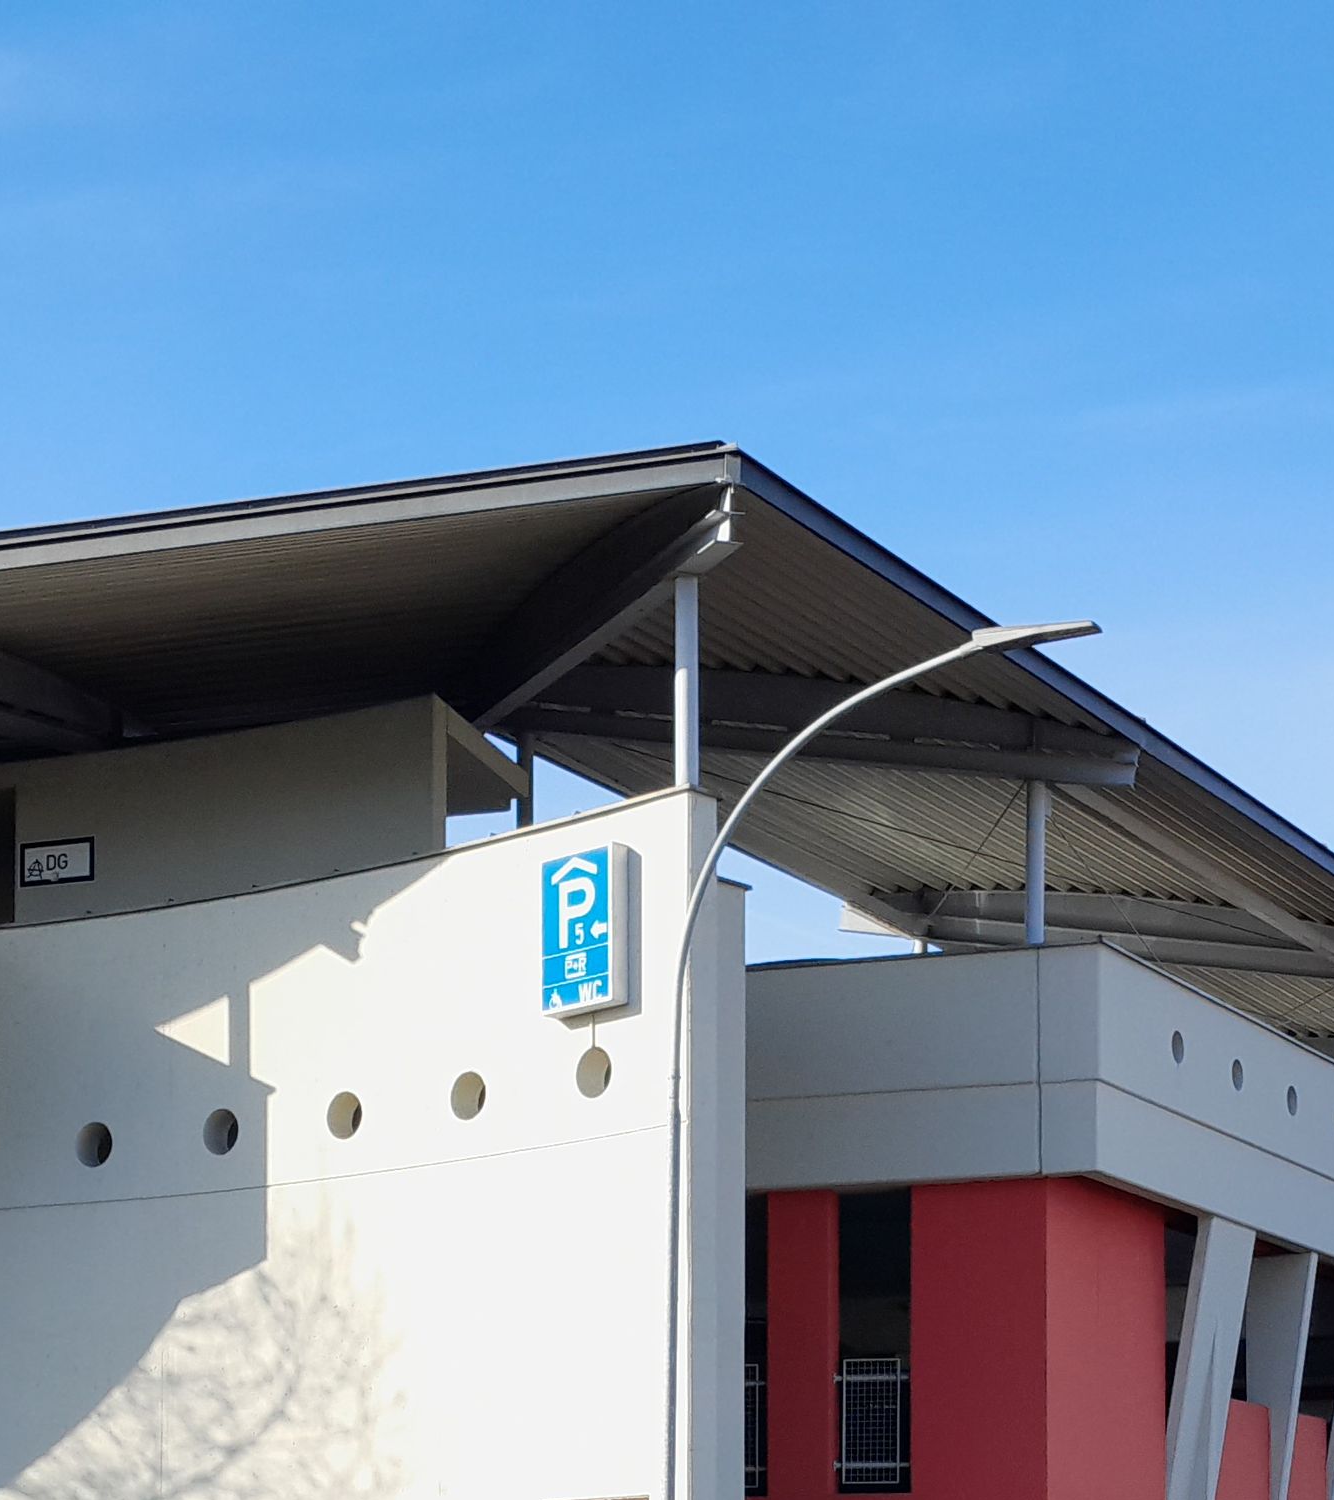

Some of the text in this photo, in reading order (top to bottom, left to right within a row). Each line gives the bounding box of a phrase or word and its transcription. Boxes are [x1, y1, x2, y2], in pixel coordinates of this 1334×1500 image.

[46, 853, 68, 871] DG
[558, 876, 595, 949] P
[574, 922, 584, 945] 5
[566, 957, 587, 973] P+R
[578, 980, 602, 1003] WC
